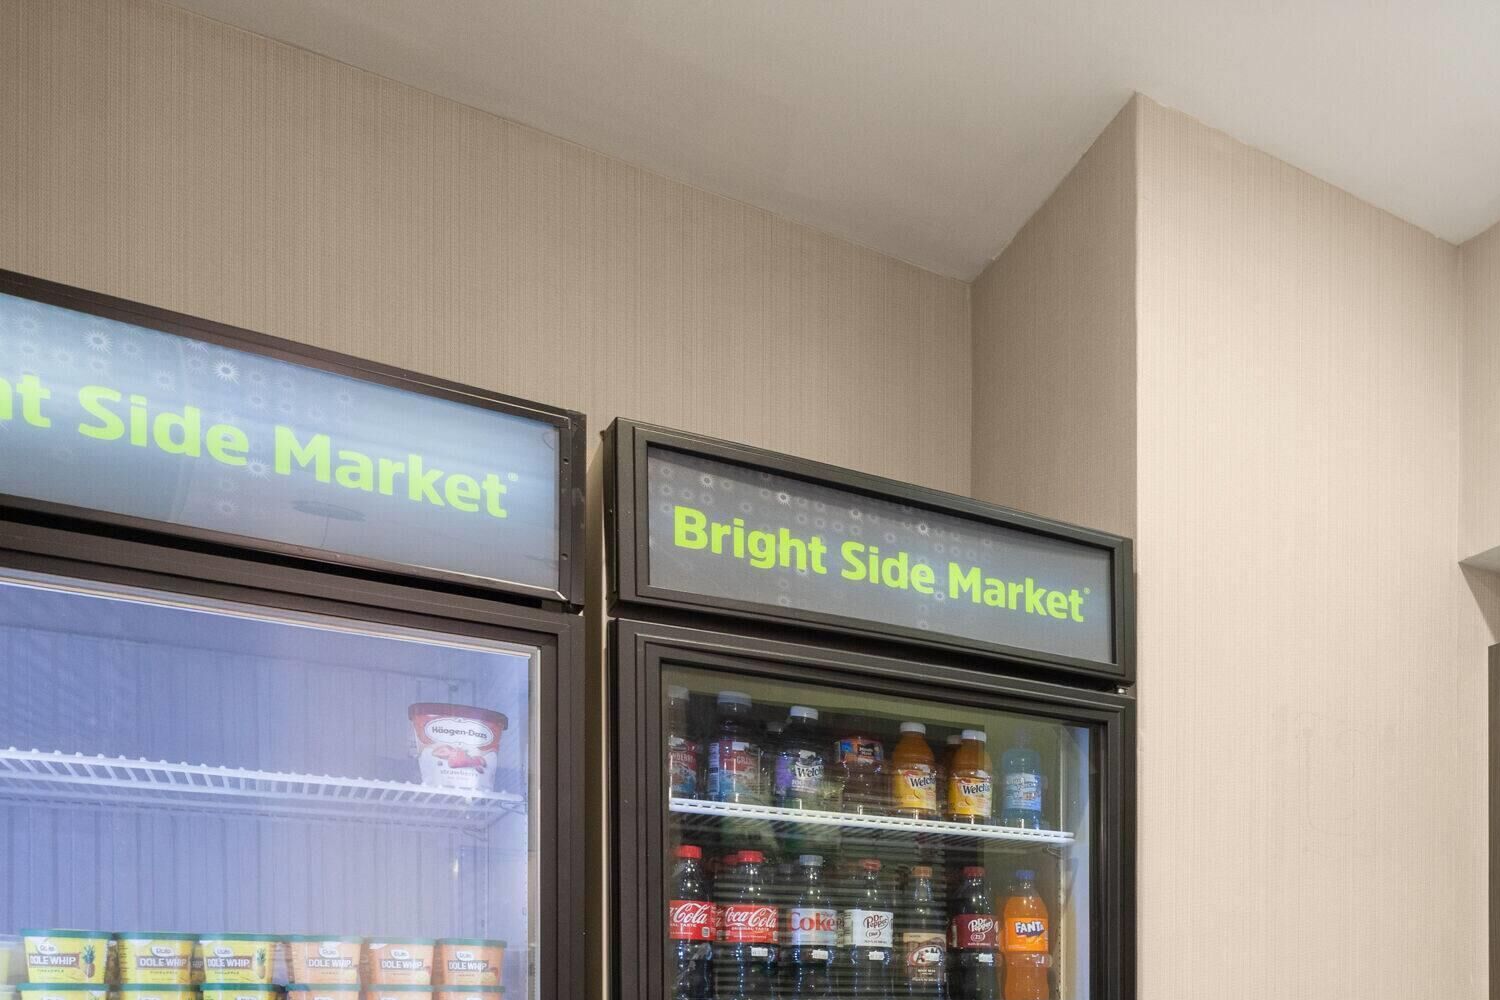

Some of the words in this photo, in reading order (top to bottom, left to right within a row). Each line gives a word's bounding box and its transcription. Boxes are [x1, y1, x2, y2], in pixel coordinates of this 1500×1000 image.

[78, 385, 249, 466] Side
[274, 427, 508, 519] Market
[673, 505, 827, 575] Bright
[841, 541, 936, 594] Side
[949, 562, 1085, 622] Market
[30, 956, 49, 965] DOLE
[50, 956, 76, 965] WHIP
[140, 958, 159, 967] DOLE
[161, 958, 186, 967] WHIP
[208, 958, 225, 967] DOLE
[226, 958, 250, 967] WHIP
[309, 960, 330, 968] DOLE
[332, 960, 351, 968] WHIP
[381, 961, 402, 969] DOLE
[403, 961, 422, 969] WHIP
[449, 962, 467, 970] DOLE
[468, 962, 487, 970] WHIP
